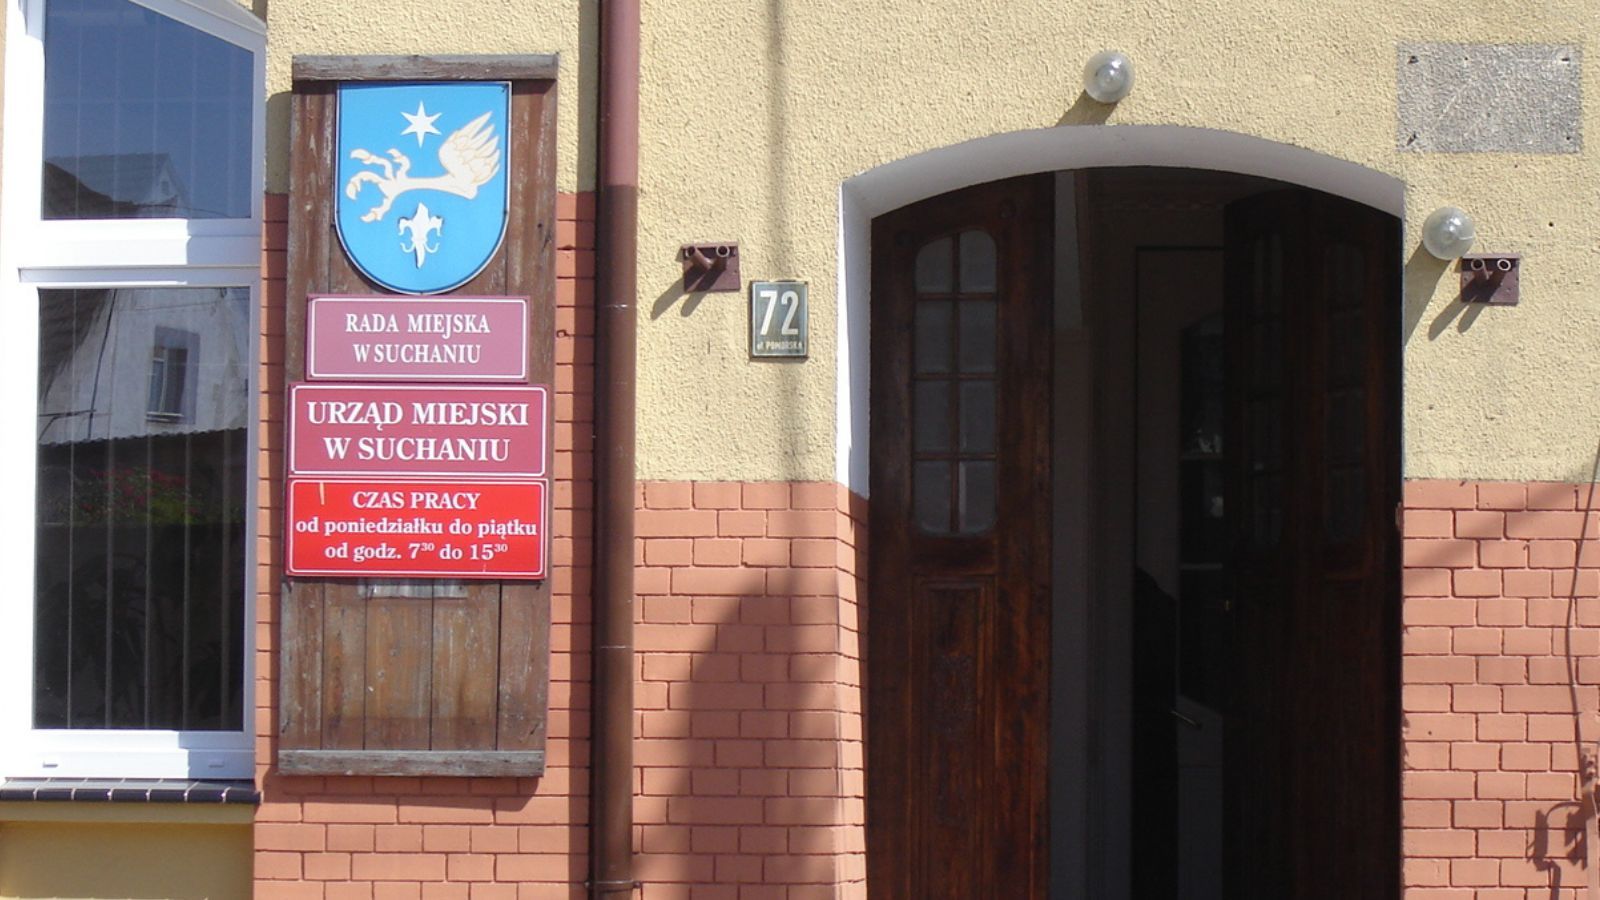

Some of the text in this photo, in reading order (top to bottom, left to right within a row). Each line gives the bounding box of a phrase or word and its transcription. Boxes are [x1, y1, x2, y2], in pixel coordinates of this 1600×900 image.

[760, 290, 799, 336] 72
[345, 313, 491, 339] RADA MIEJSKA
[353, 344, 481, 364] W SUCHANIU
[306, 401, 529, 430] URZĄD MIEJSKI
[323, 437, 511, 462] W SUCHANIU
[352, 491, 481, 510] CZAS PRACY
[296, 517, 538, 540] od poniedziałku do piątku
[324, 542, 348, 559] od
[353, 543, 401, 562] godz.
[439, 544, 463, 560] do
